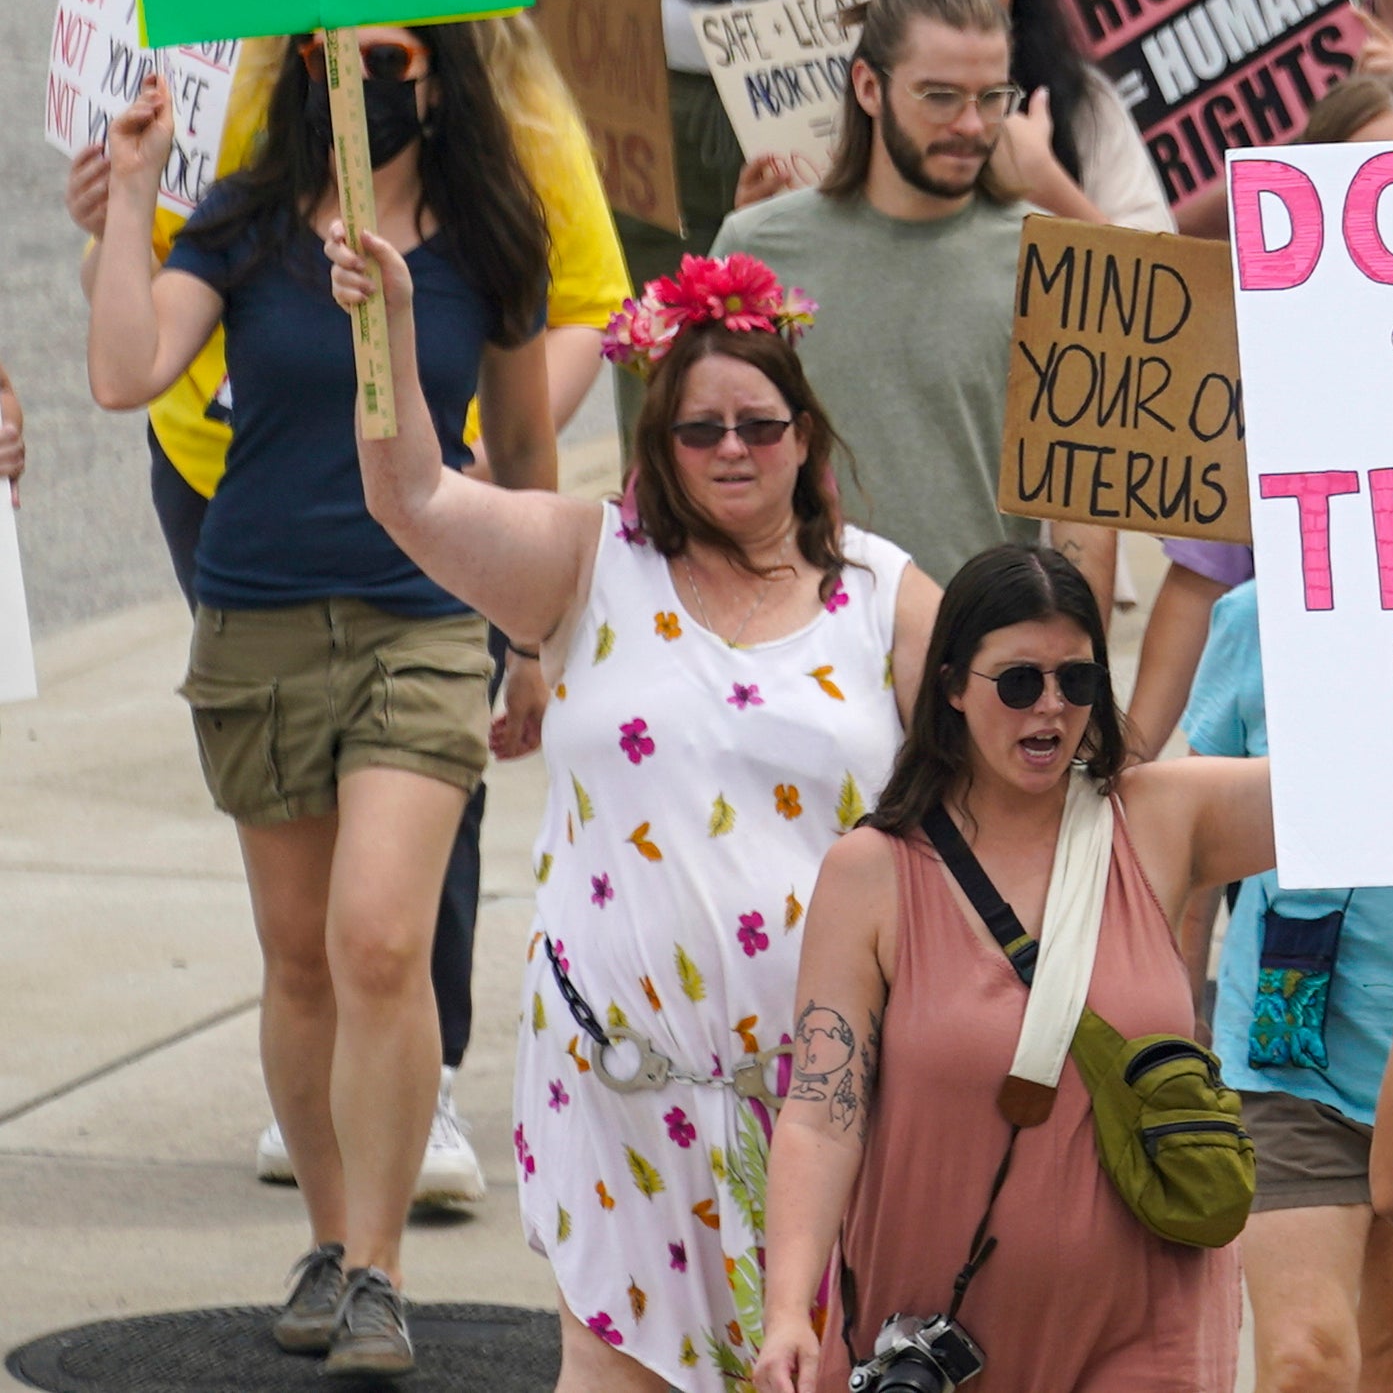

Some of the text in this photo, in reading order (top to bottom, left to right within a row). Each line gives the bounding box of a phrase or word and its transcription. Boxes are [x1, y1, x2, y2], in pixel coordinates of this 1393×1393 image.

[53, 5, 97, 76] NOT
[702, 10, 773, 68] SAFE
[47, 70, 80, 148] NOT
[744, 54, 851, 121] ABORTIO
[1147, 23, 1356, 206] RIGHTS
[1018, 242, 1191, 345] MIND
[1018, 340, 1177, 434] YOUR
[1017, 438, 1229, 525] UTERUS
